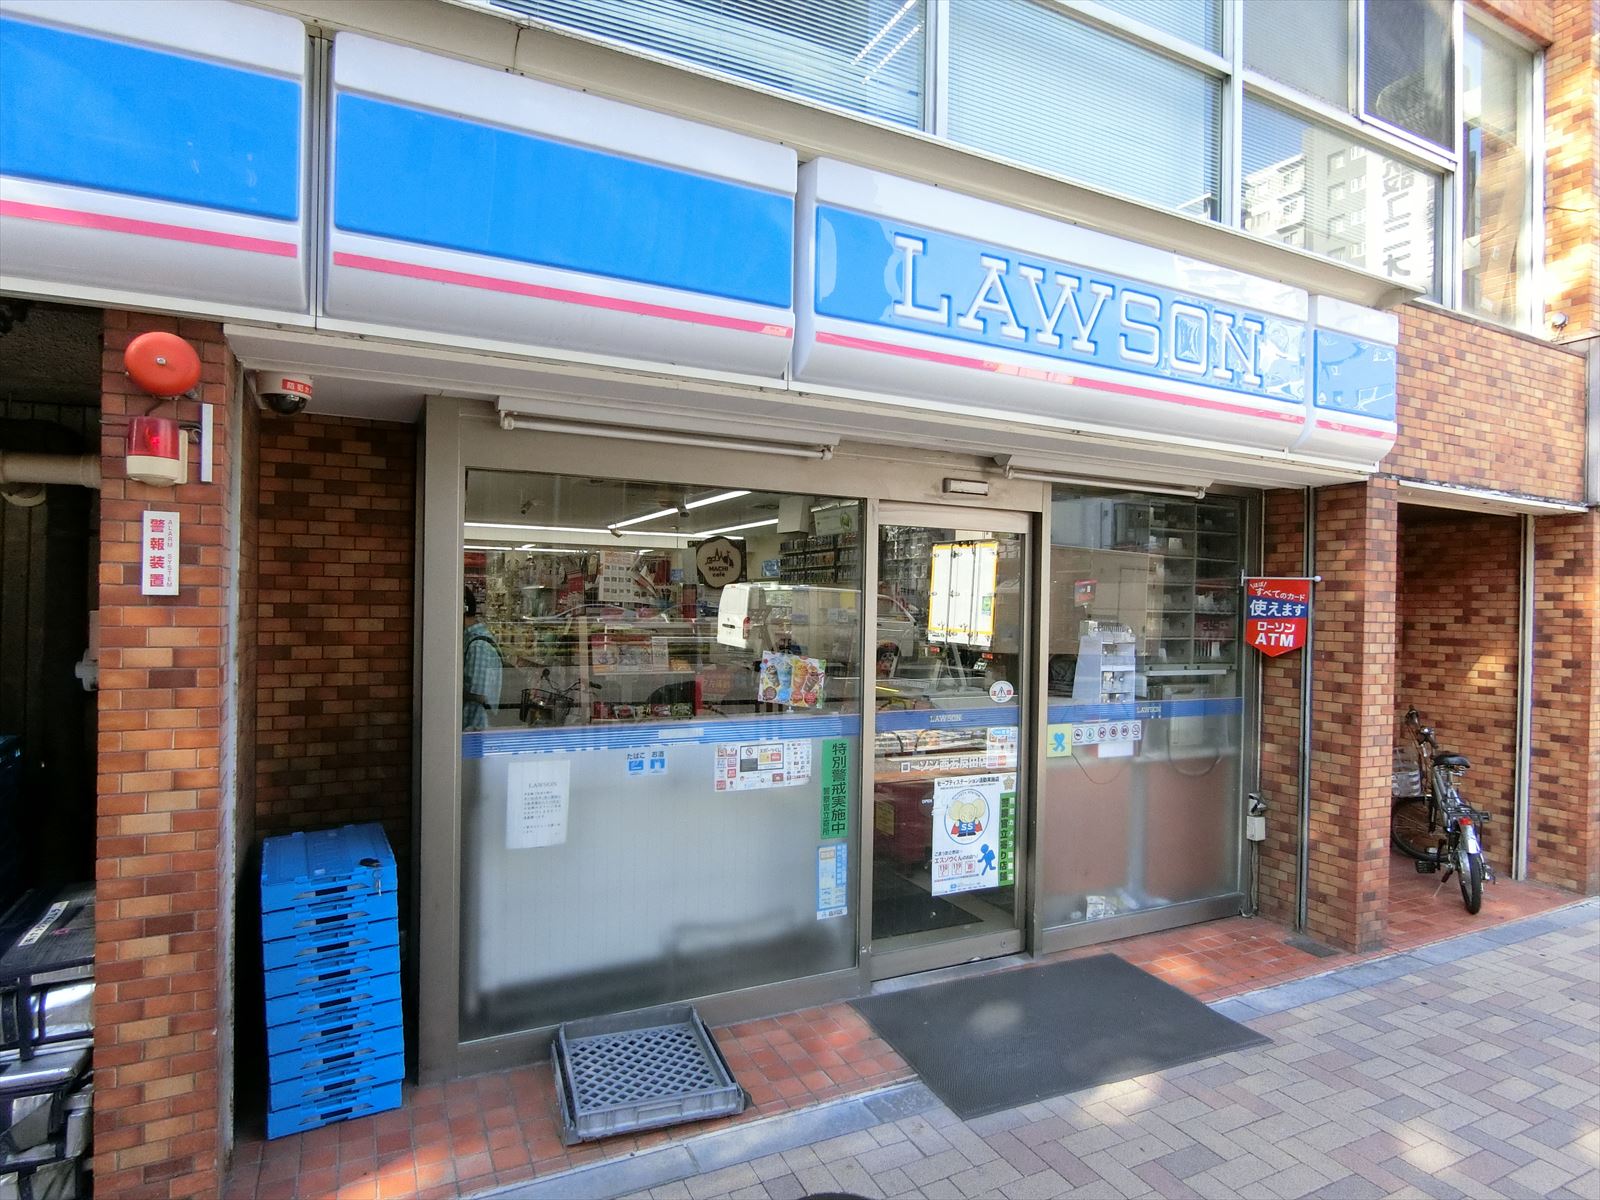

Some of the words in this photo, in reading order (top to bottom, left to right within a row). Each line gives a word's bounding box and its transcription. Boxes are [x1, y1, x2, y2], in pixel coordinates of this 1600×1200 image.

[893, 234, 1264, 388] LAWSON
[149, 518, 165, 587] 警報装置
[1255, 587, 1306, 601] すべてのカード
[1249, 599, 1305, 617] 使えます
[1257, 621, 1296, 633] ローソン
[1255, 632, 1294, 647] ATM
[1136, 706, 1161, 714] LAWSON
[929, 714, 962, 722] LAWSON
[626, 752, 645, 760] たばこ
[651, 750, 664, 758] お酒
[831, 742, 847, 834] 特別警戒実施中
[961, 822, 974, 831] SS
